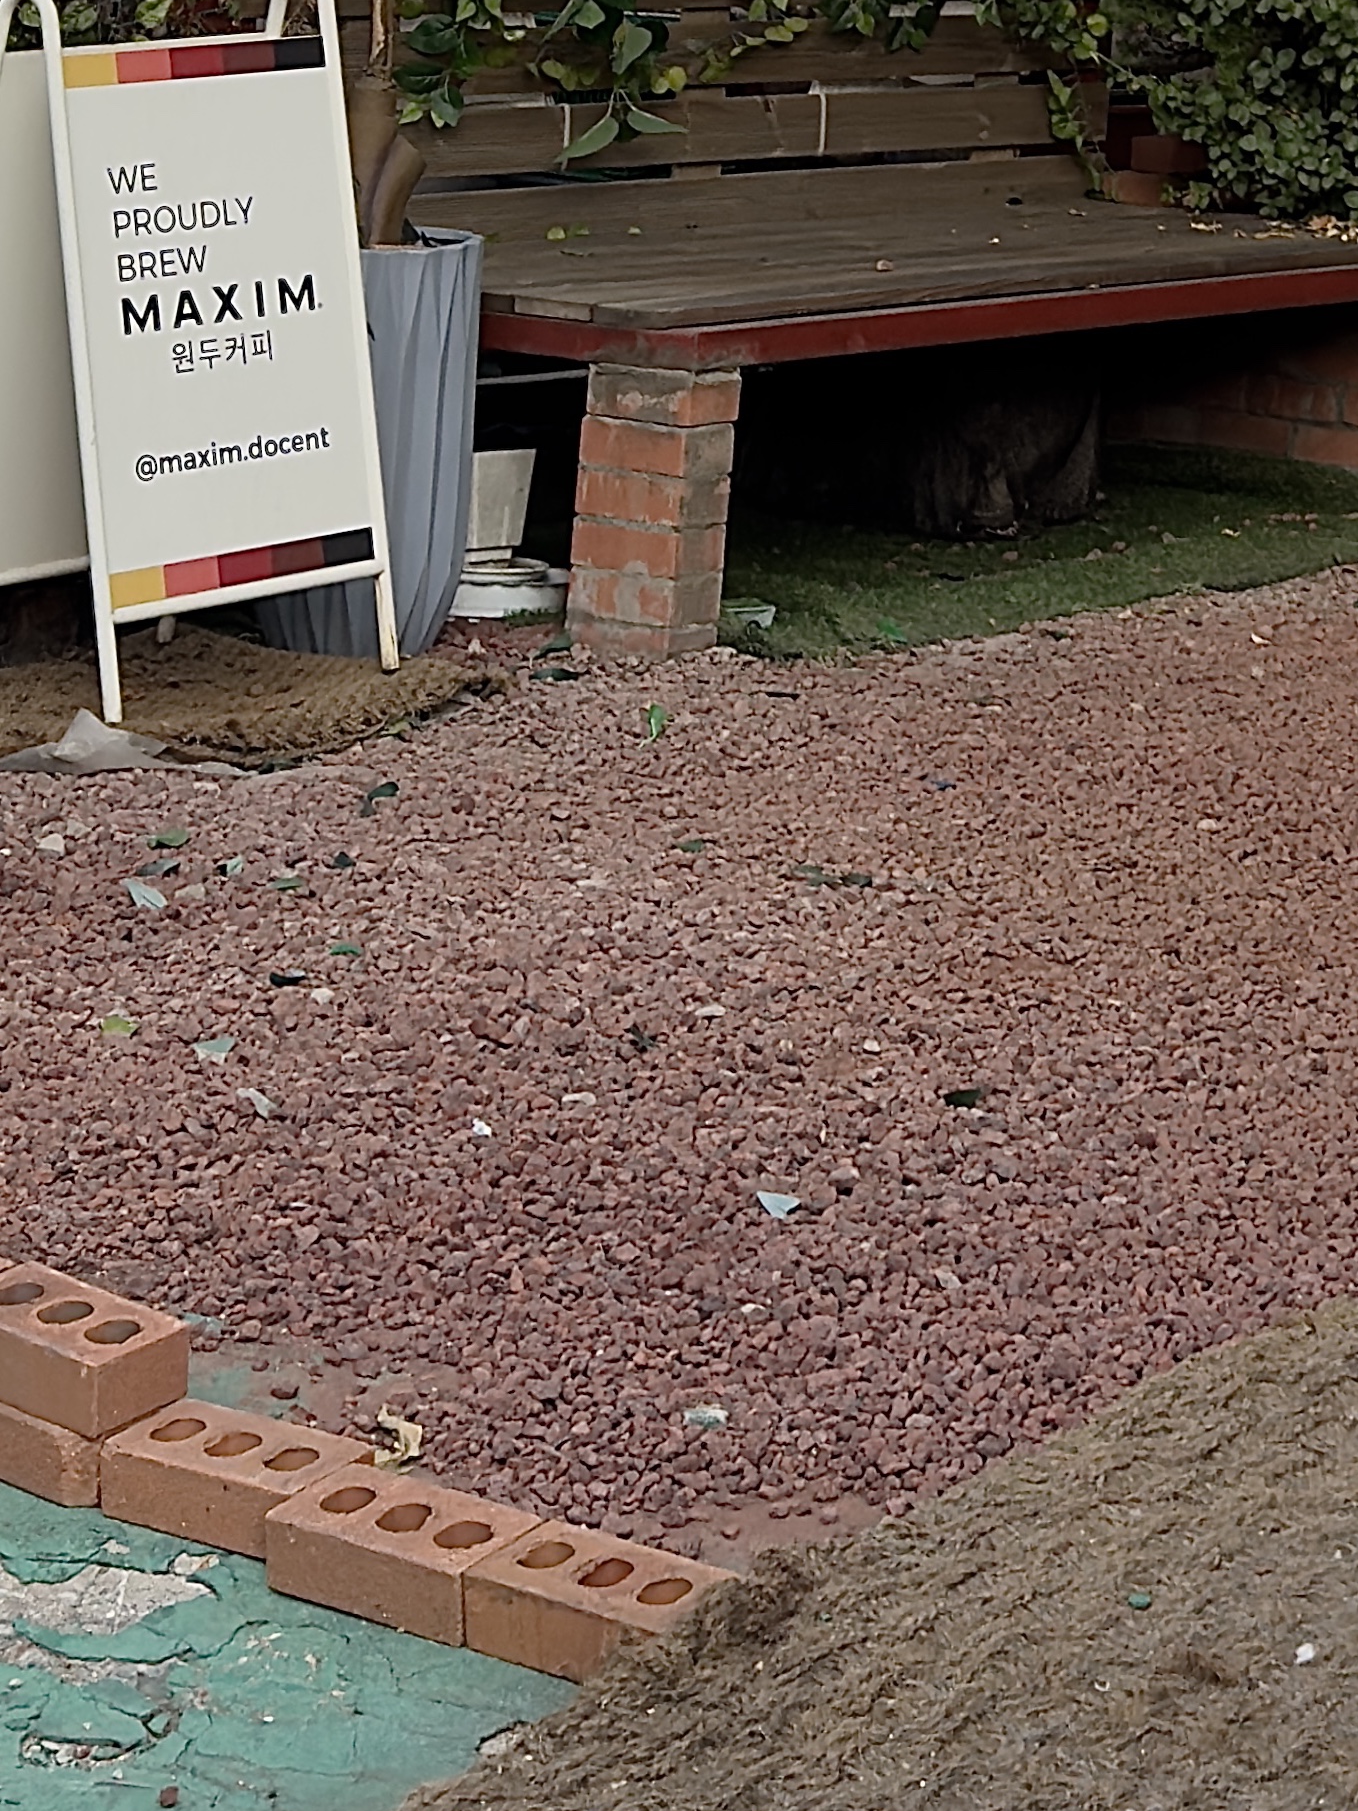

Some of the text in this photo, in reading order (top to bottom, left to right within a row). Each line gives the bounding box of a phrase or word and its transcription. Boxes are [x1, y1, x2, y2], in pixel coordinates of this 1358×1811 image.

[107, 162, 158, 195] WE
[112, 195, 254, 239] PROUDLY
[116, 244, 207, 283] BREW
[121, 273, 316, 336] MAXIM
[172, 329, 274, 374] 원두커피
[135, 426, 331, 483] @maxim.docent
